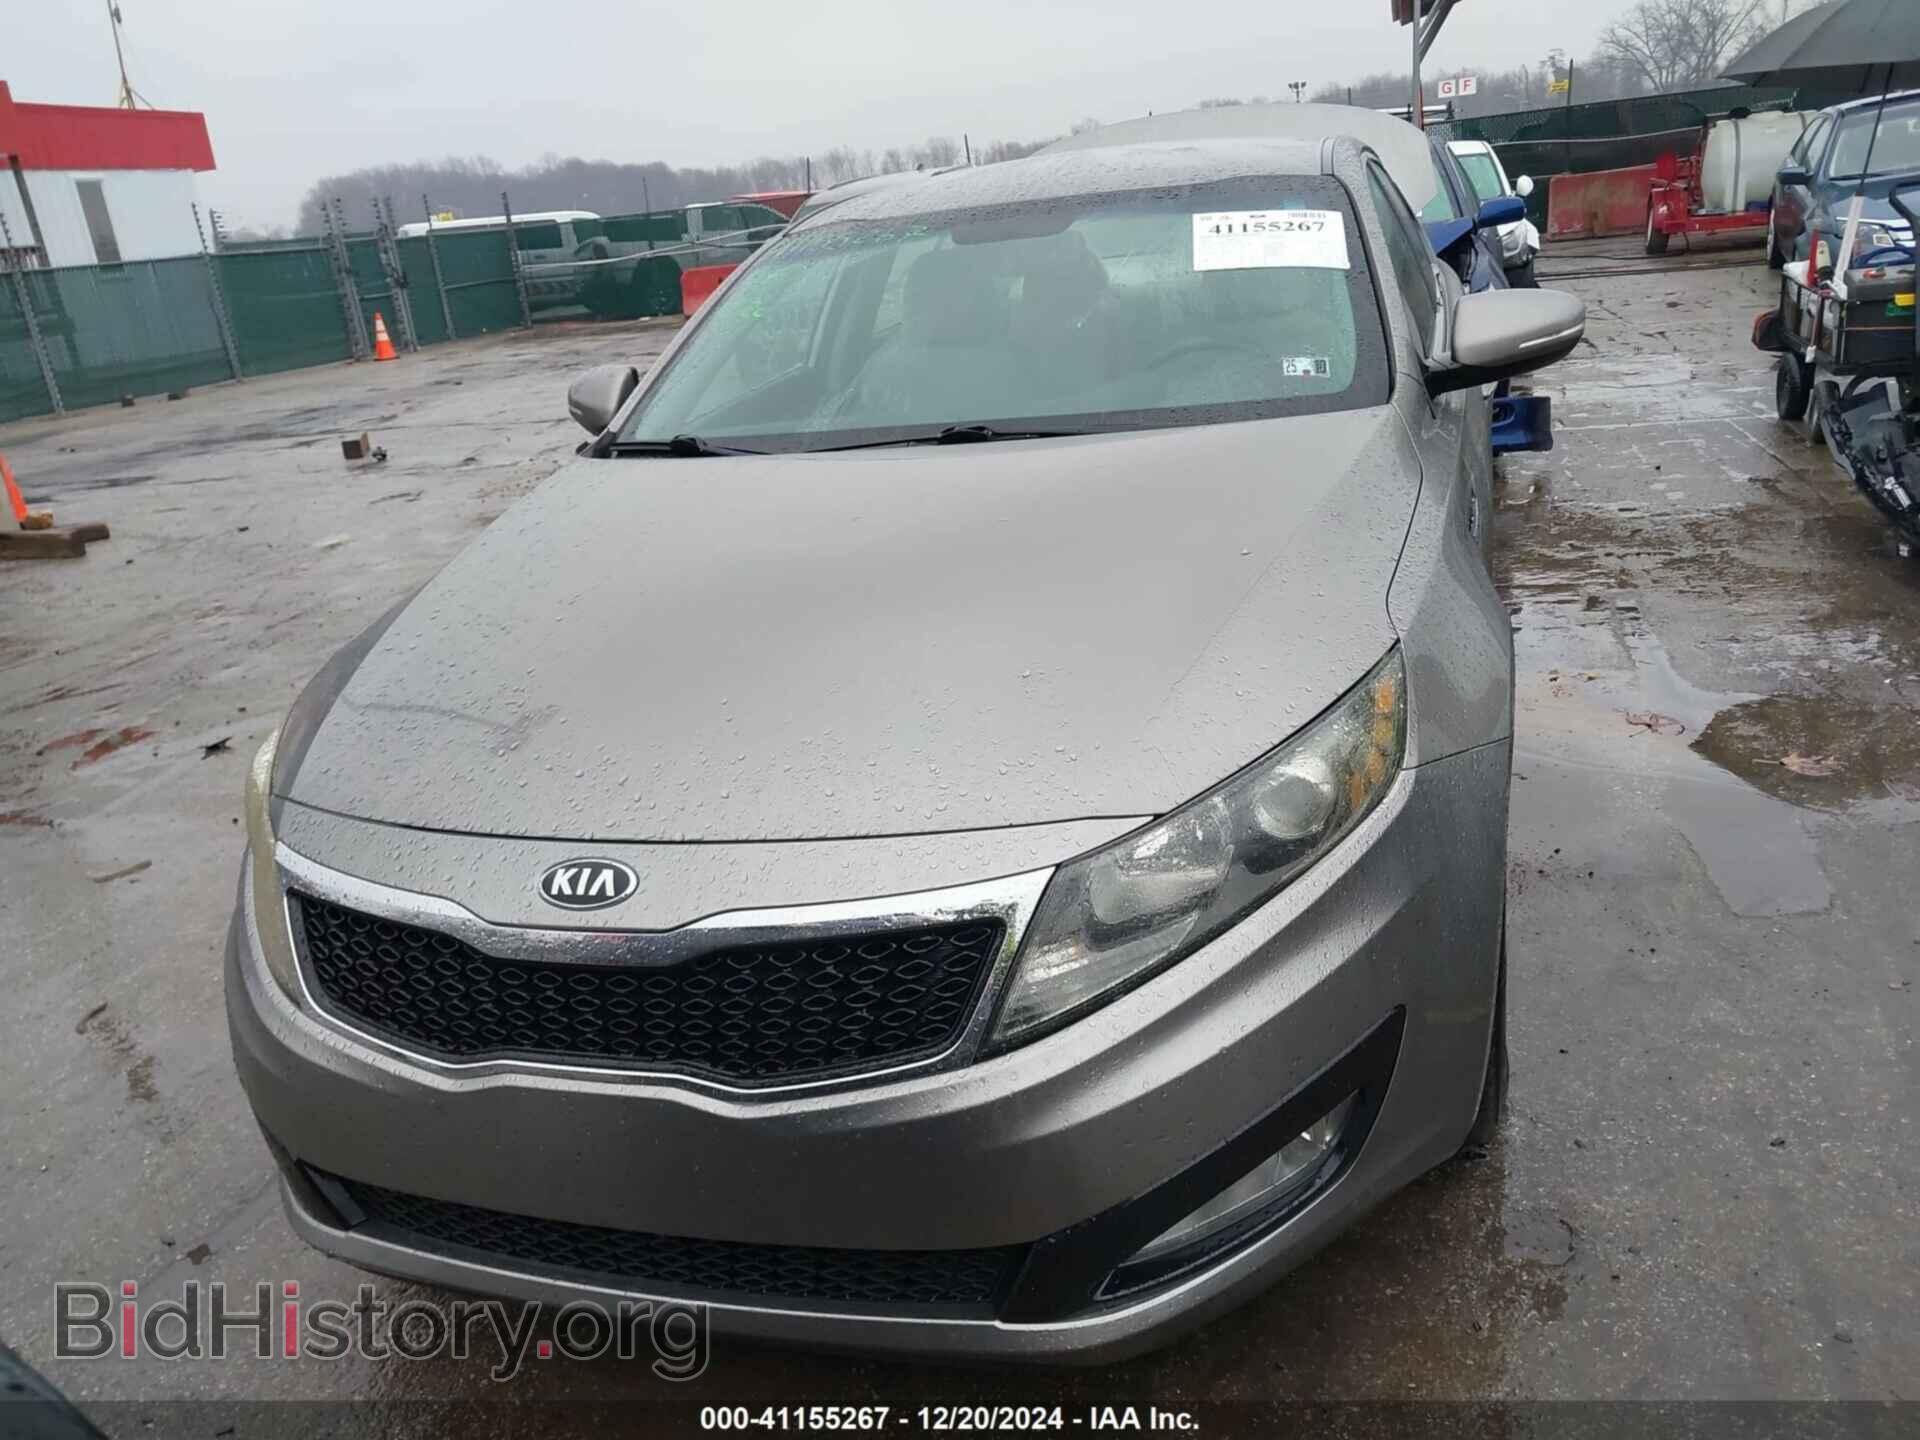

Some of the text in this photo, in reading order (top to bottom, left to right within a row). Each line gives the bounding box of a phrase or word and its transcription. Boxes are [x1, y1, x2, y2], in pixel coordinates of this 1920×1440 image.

[1441, 79, 1471, 94] G F
[1208, 221, 1325, 234] 41155267
[1286, 359, 1297, 373] 25
[550, 867, 615, 897] KIA
